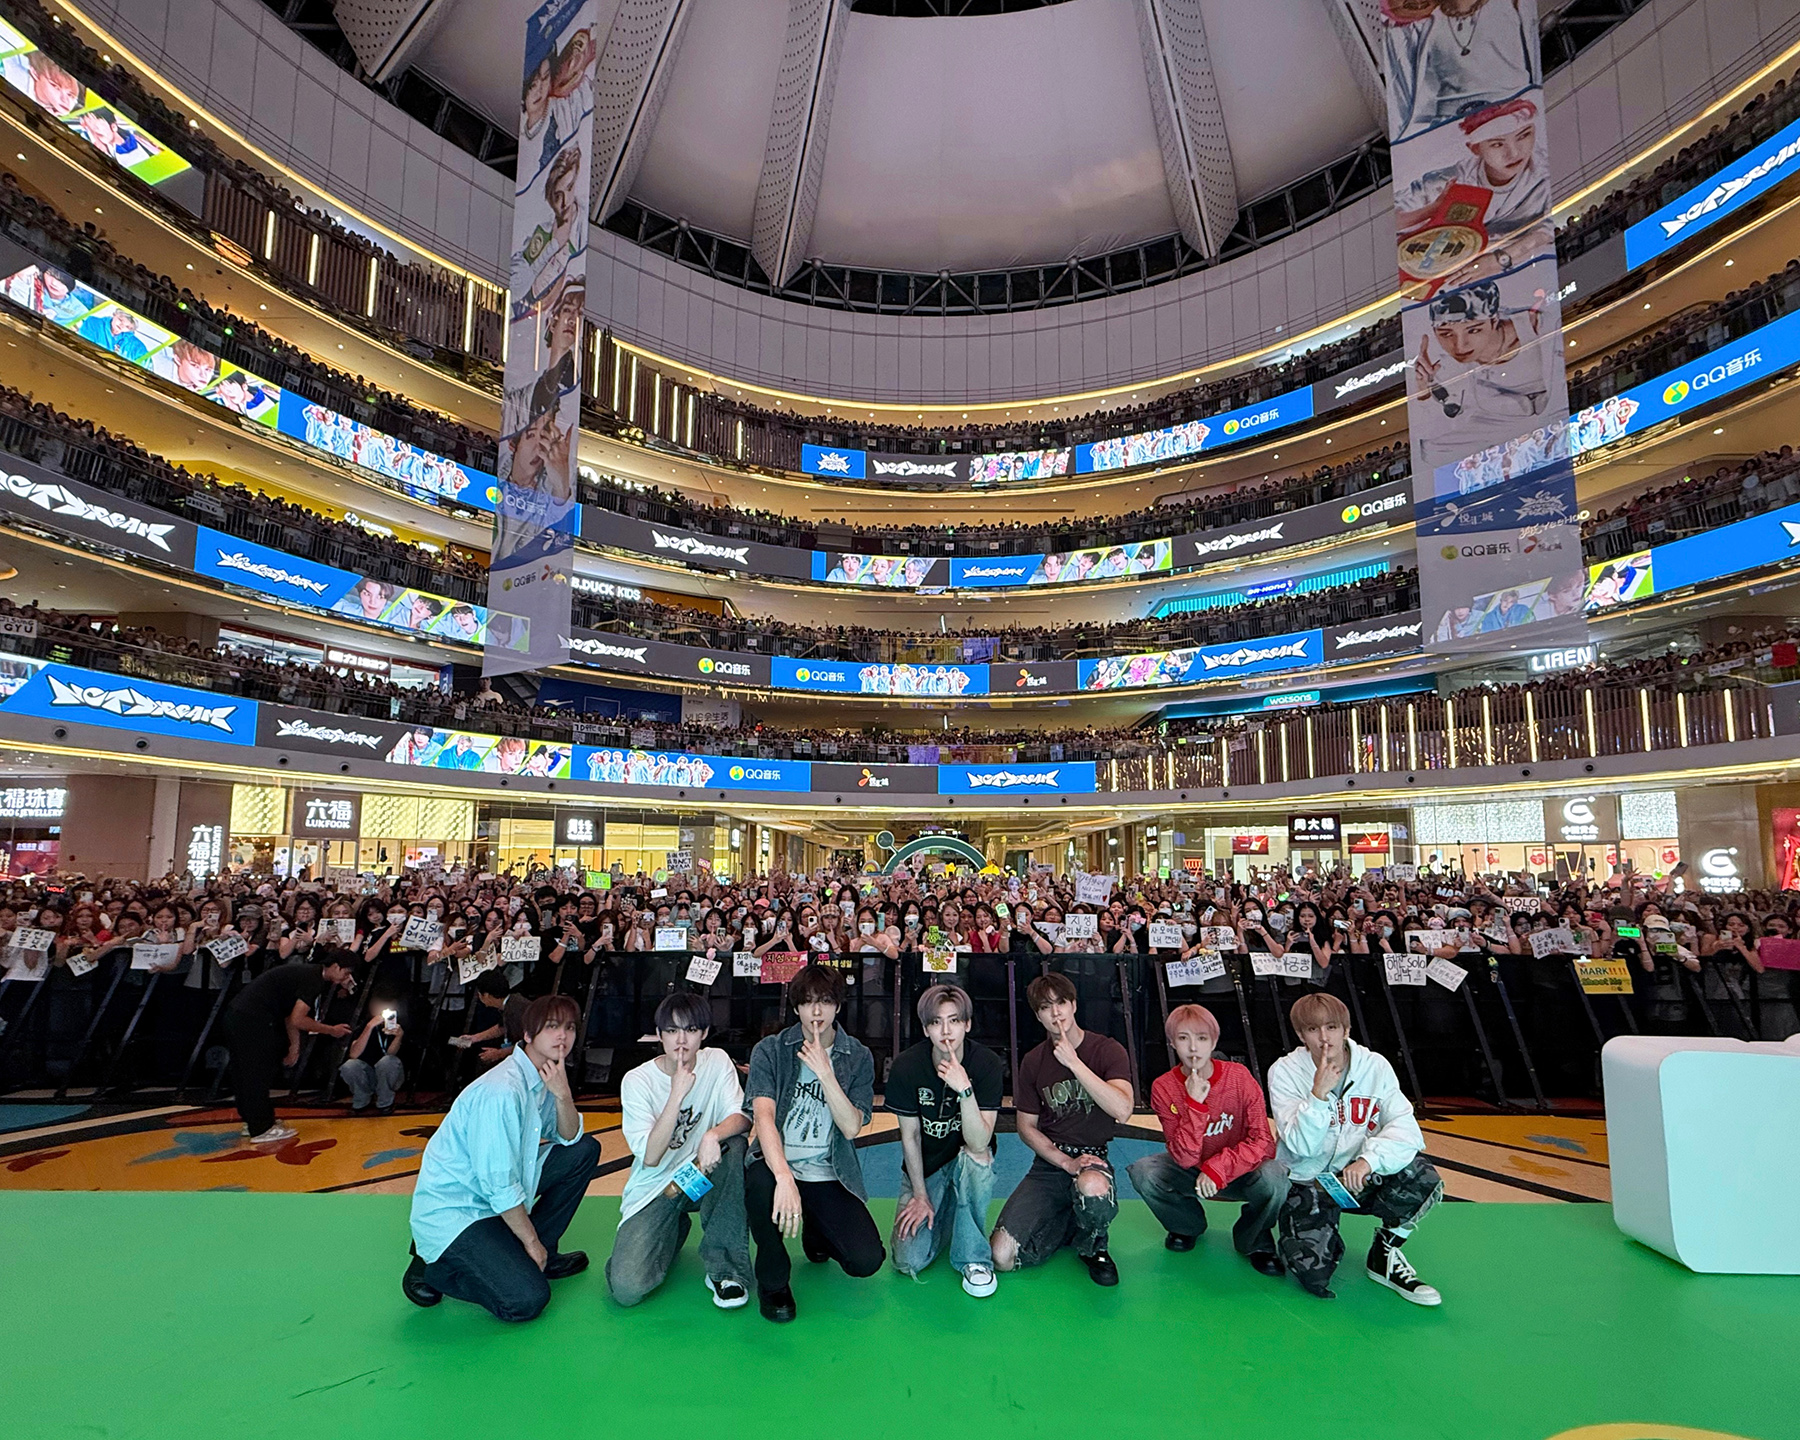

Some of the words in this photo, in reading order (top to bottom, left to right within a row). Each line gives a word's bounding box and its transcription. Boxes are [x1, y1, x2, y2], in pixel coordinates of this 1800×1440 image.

[1692, 348, 1763, 391] QQ音乐
[1240, 407, 1280, 430] QQ音乐
[1360, 492, 1407, 518] QQ音乐
[1461, 541, 1512, 558] QQ音乐
[513, 572, 537, 588] QQ音乐
[571, 576, 614, 596] B.DUCK
[617, 586, 641, 601] KIDS
[714, 662, 751, 676] QQ音乐
[811, 671, 846, 683] QQ音乐
[1269, 693, 1312, 705] watsons
[745, 769, 781, 781] QQ音乐
[306, 798, 352, 821] 六福
[305, 819, 351, 829] LUKFOOK
[1293, 817, 1335, 831] 周大福
[187, 824, 213, 879] 六福珠
[1504, 896, 1540, 908] HOLO
[766, 953, 786, 963] 지성
[840, 960, 852, 968] 생일
